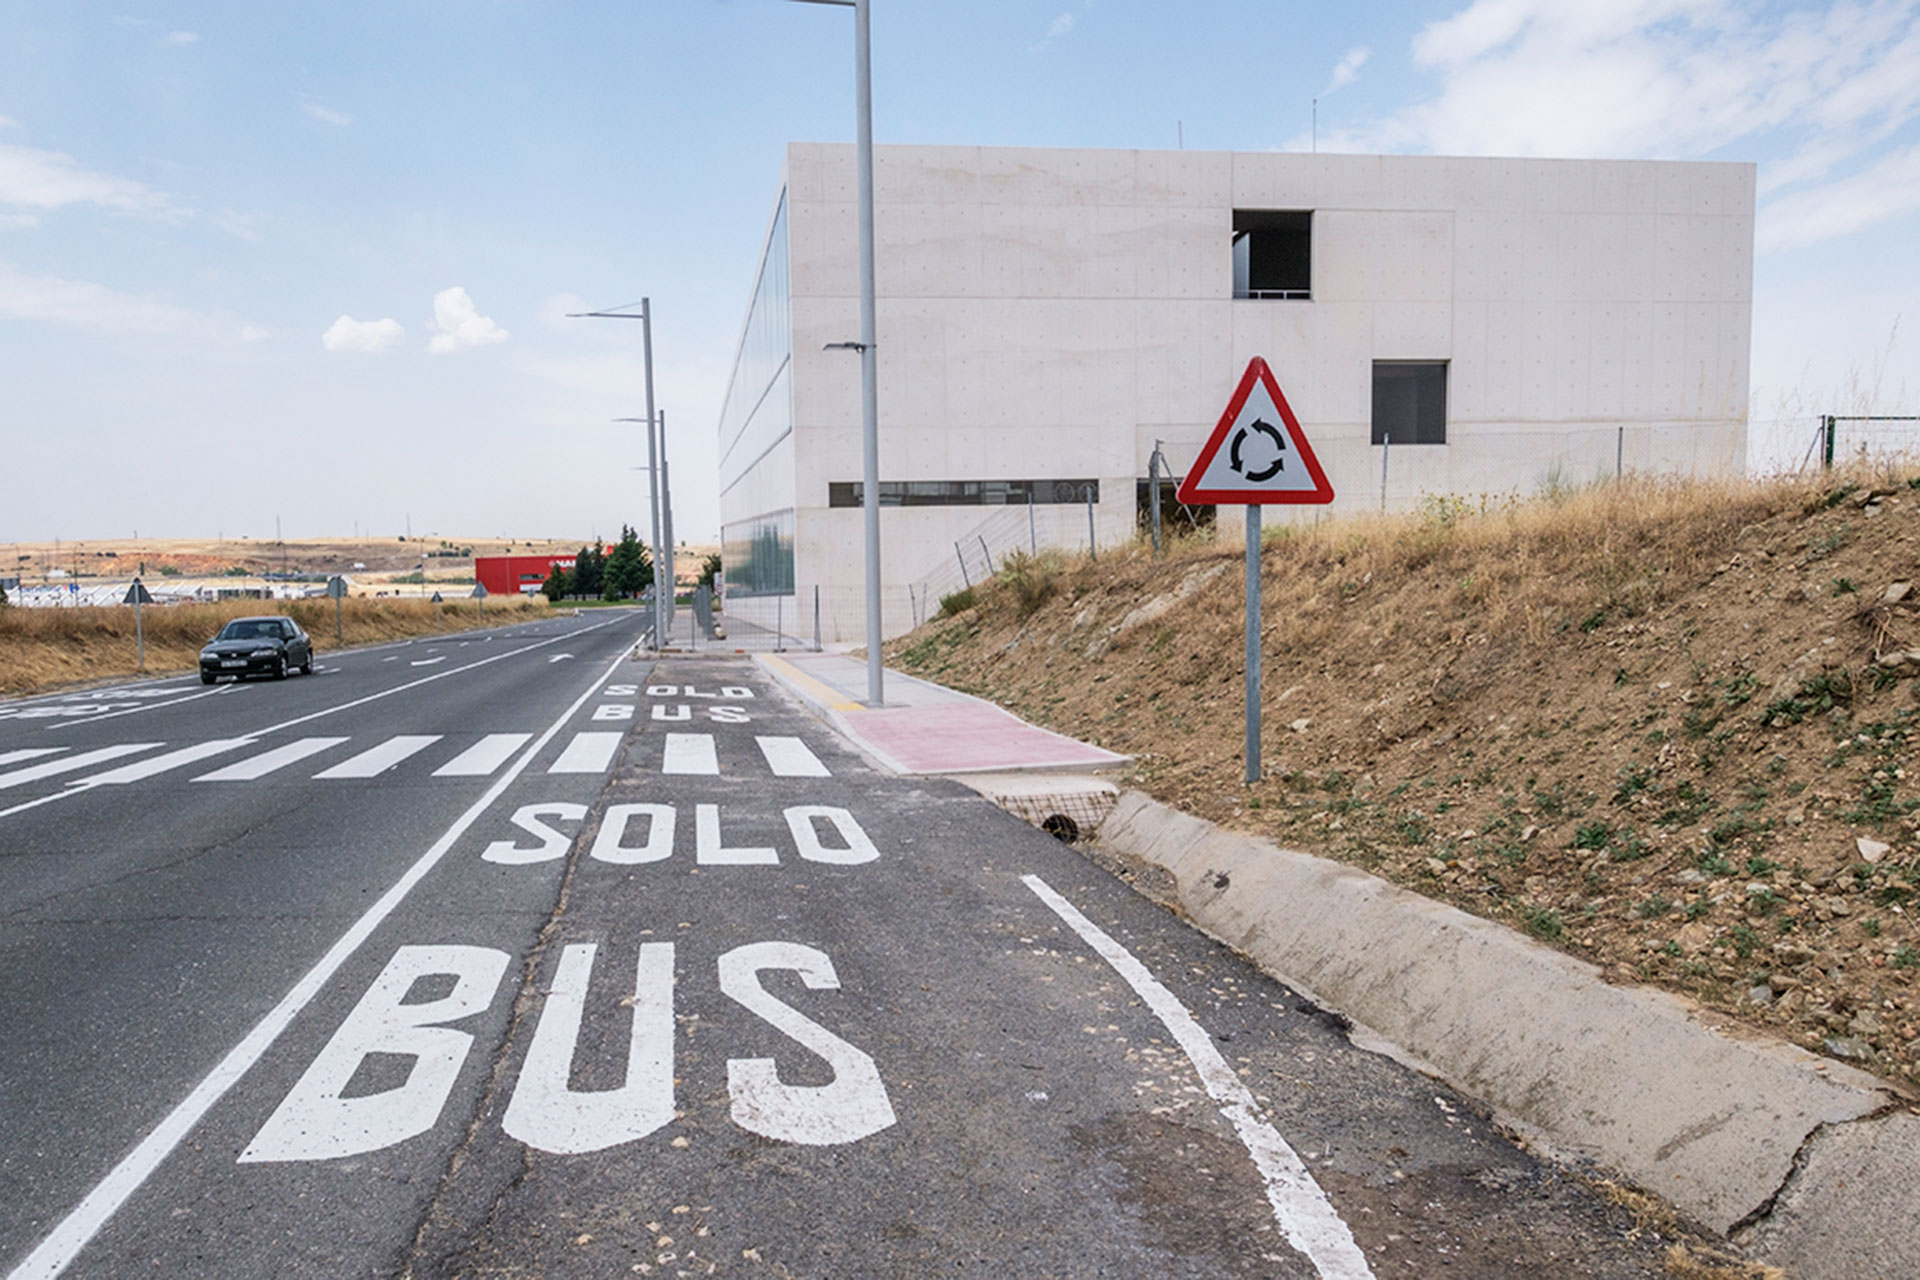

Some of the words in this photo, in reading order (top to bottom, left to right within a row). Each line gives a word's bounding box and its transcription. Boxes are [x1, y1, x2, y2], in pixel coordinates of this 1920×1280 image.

[603, 684, 755, 698] SOLO
[591, 704, 751, 723] BUS
[480, 802, 881, 865] SOLO
[236, 941, 898, 1163] BUS
